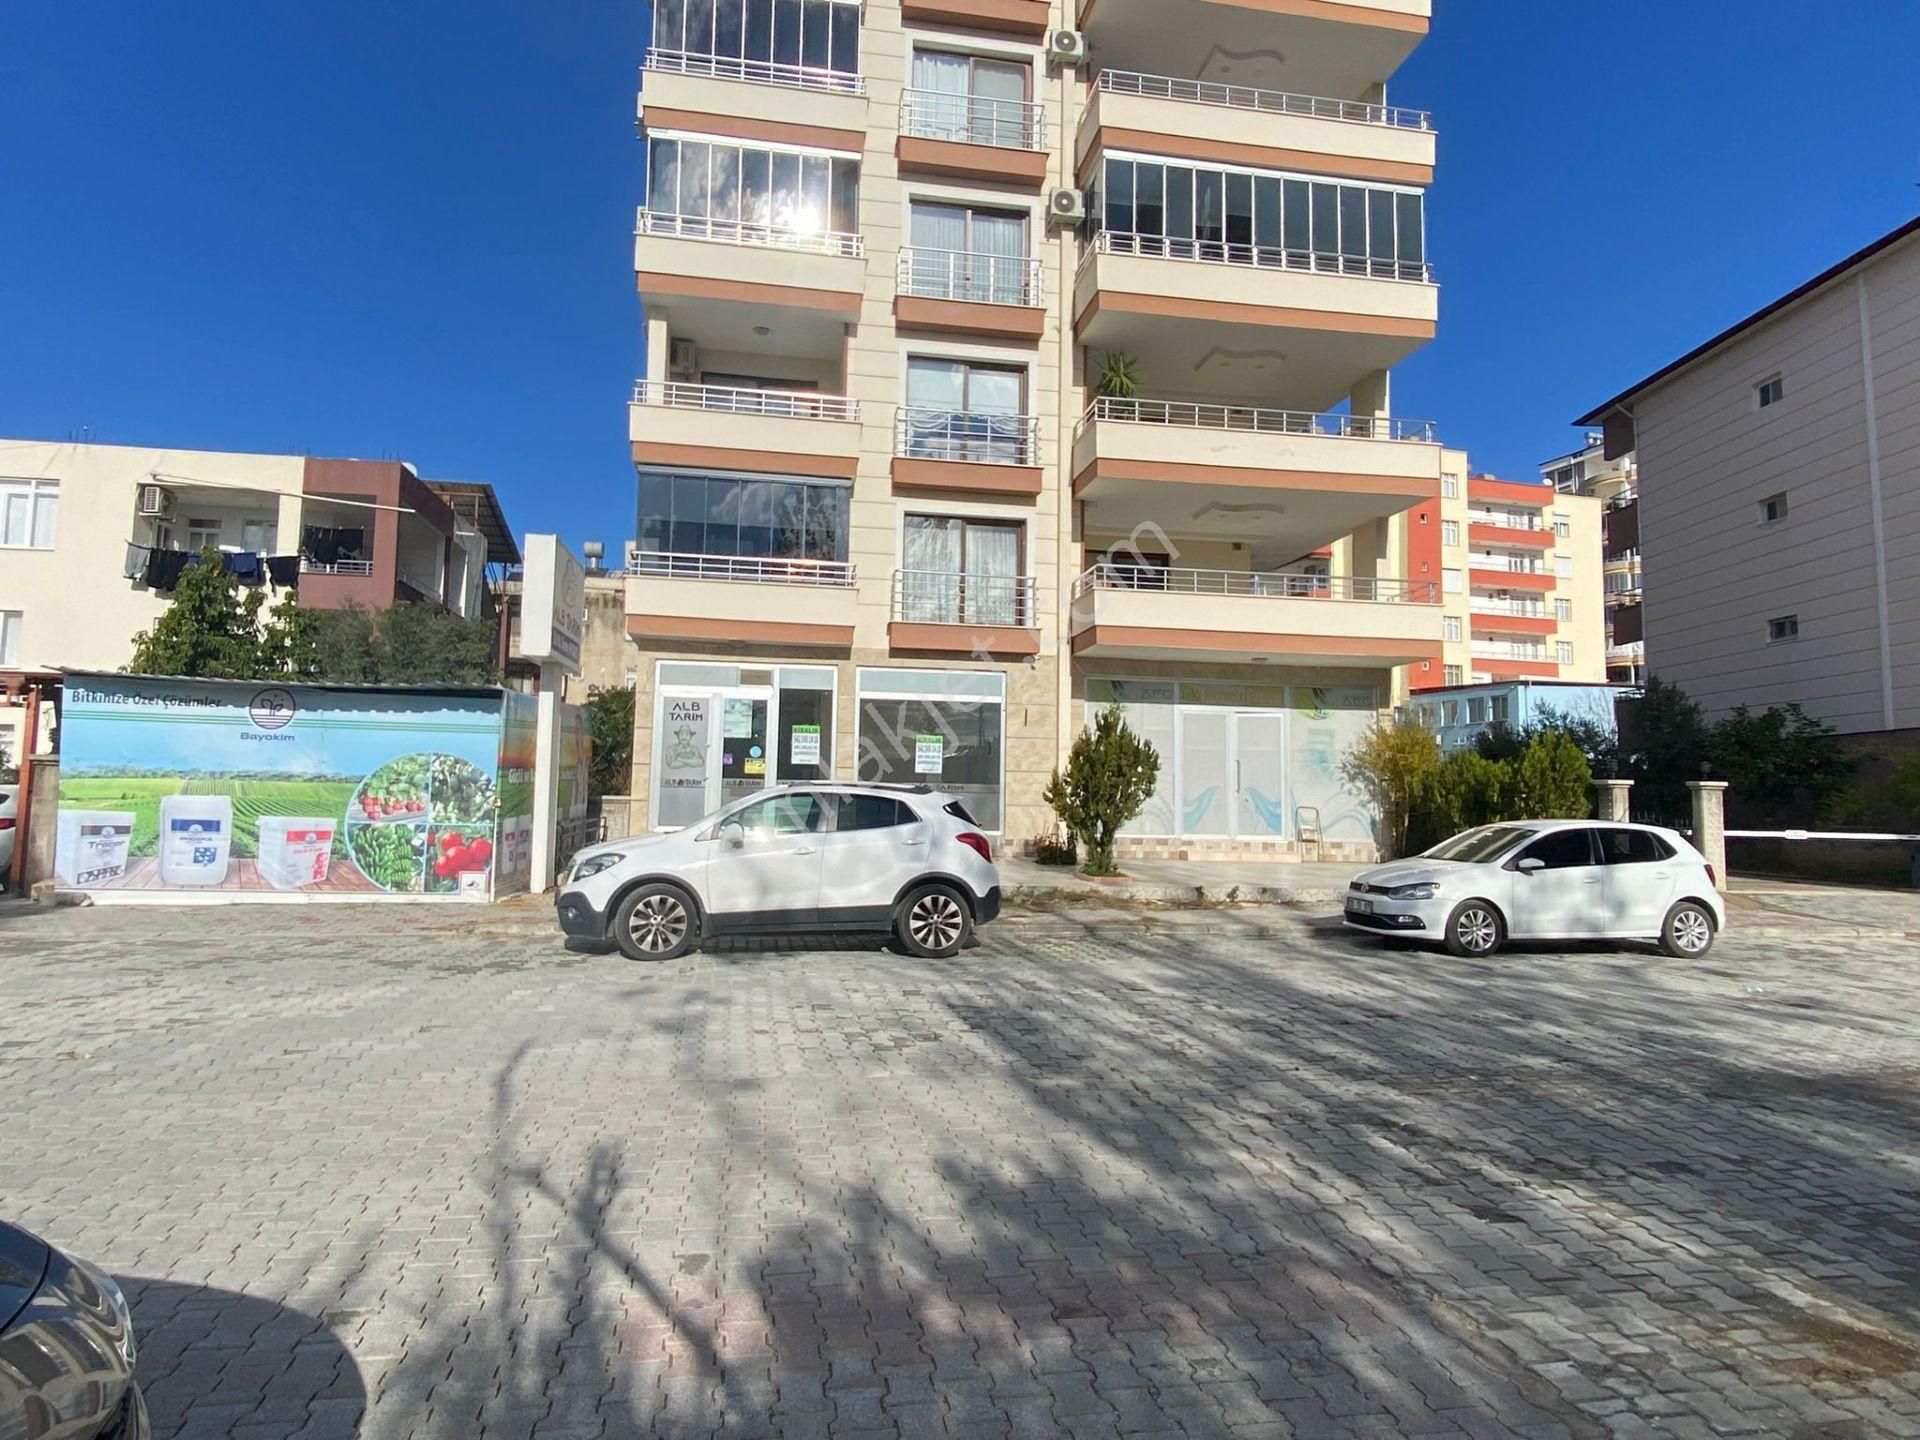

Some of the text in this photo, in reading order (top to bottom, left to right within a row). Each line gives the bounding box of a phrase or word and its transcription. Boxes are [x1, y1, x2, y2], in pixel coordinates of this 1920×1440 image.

[72, 690, 222, 709] Bitkinize Özel Çözümler
[672, 701, 701, 711] ALB
